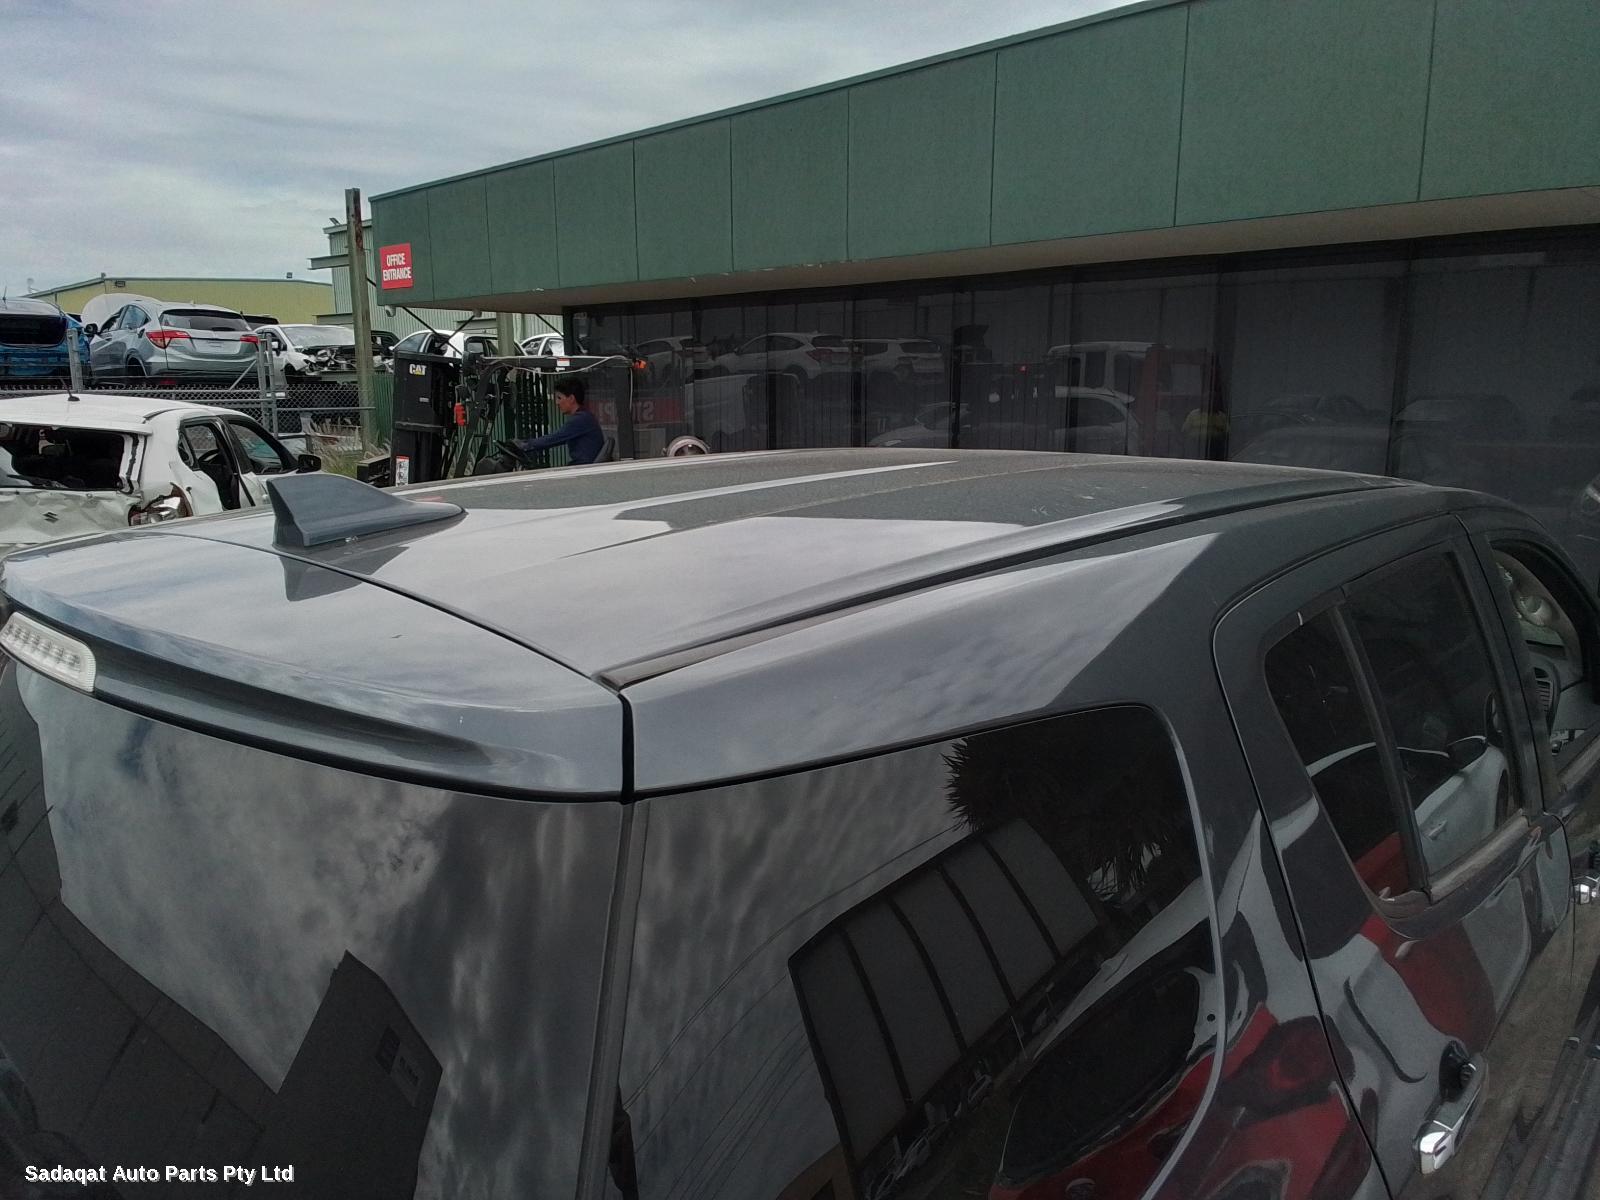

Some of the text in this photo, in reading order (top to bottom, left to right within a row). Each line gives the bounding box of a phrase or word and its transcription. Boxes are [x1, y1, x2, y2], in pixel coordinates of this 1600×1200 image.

[386, 253, 405, 266] OFFICE
[383, 267, 412, 281] ENTRANCE
[409, 363, 427, 376] CAT
